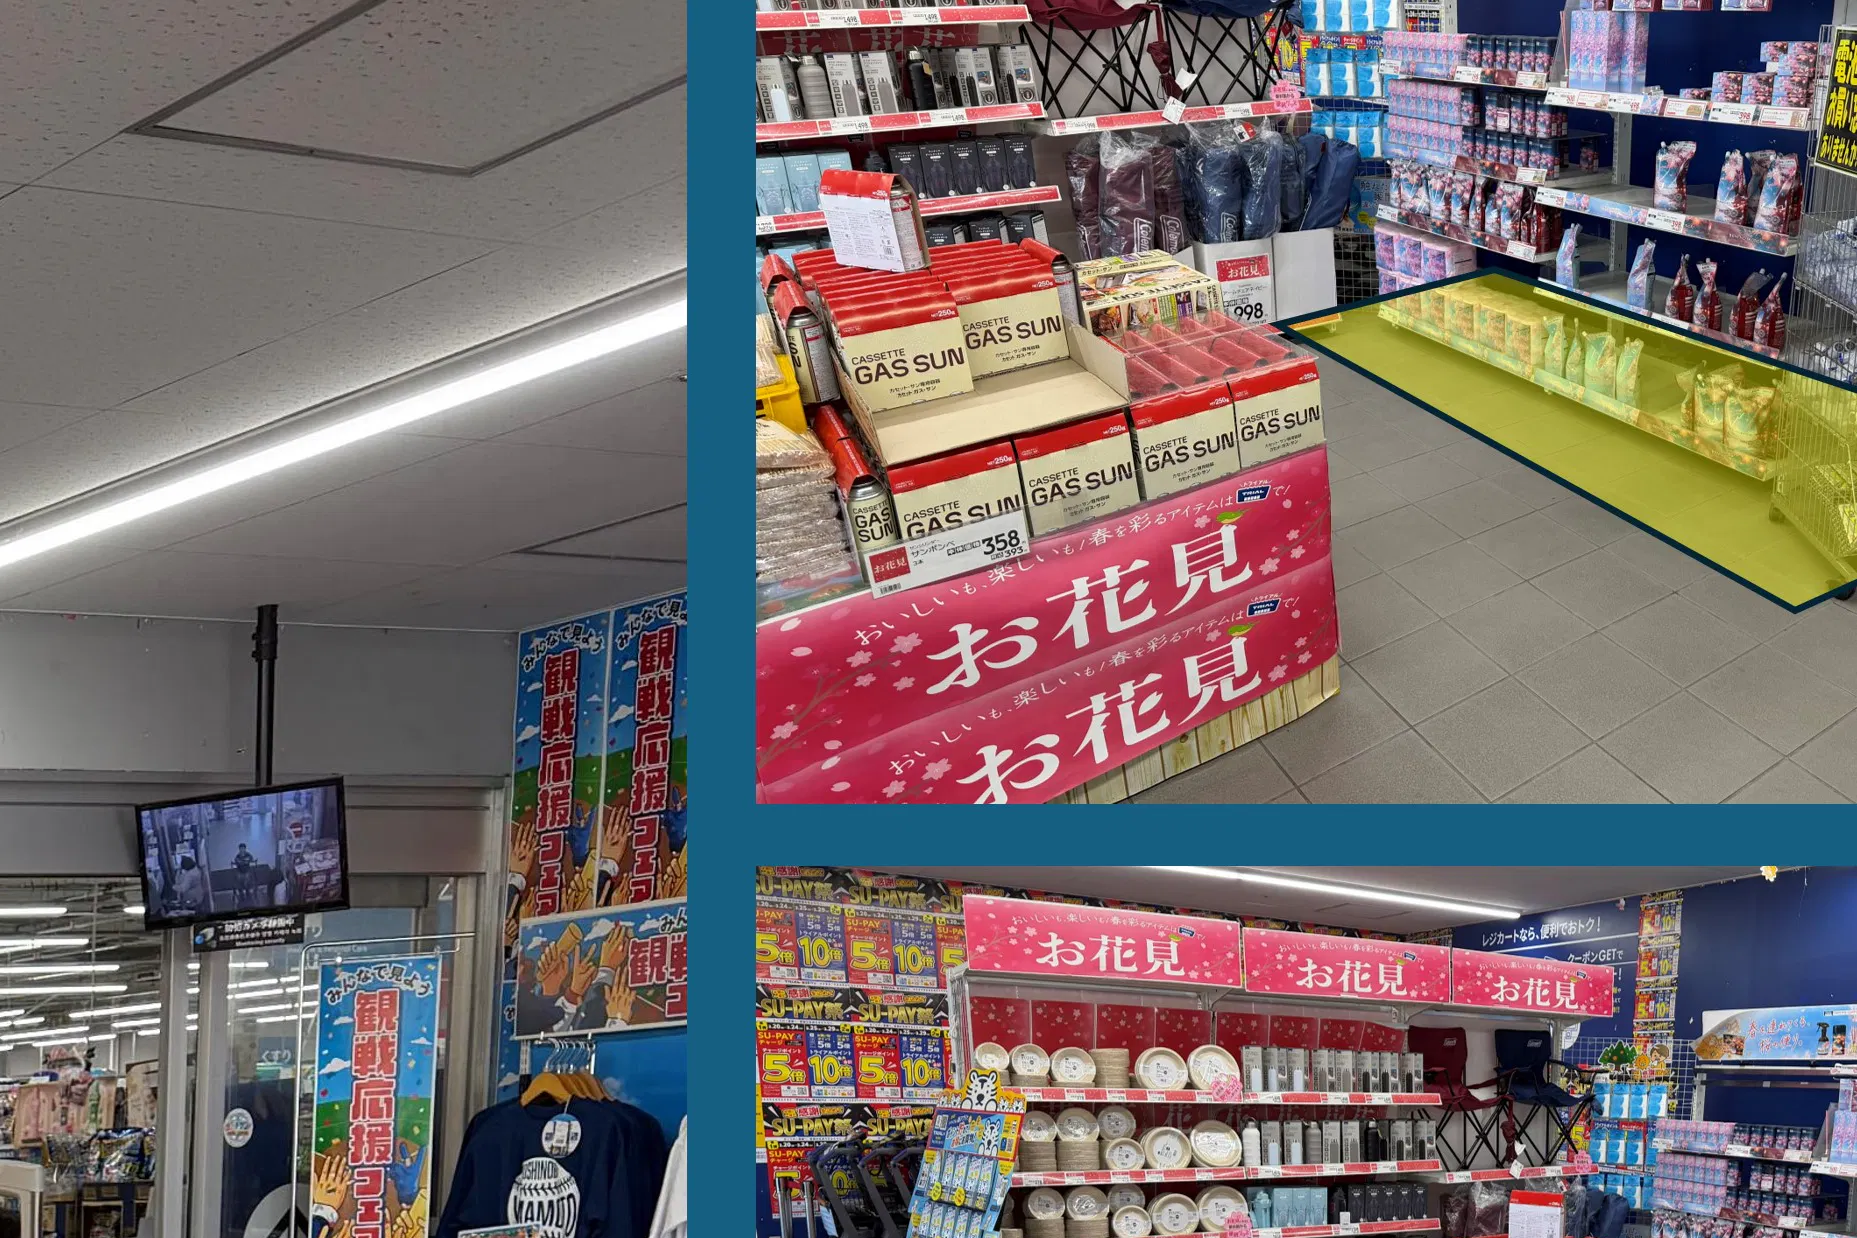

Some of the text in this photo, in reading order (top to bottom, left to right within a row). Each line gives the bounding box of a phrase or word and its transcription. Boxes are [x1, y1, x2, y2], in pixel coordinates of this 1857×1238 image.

[963, 316, 1010, 331] CASSETTE
[965, 315, 1061, 349] GAS SUN
[851, 348, 905, 365] CASSETTE
[855, 348, 965, 385] GAS SUN
[1240, 409, 1279, 426] CASSETTE
[1241, 405, 1320, 442] GAS SUN
[1144, 436, 1187, 454] CASSETTE
[1145, 431, 1234, 473] GAS SUN
[1029, 468, 1078, 488] CASSETTE
[1031, 461, 1133, 506] GAS SUN
[855, 507, 891, 529] GAS
[904, 501, 960, 522] CASSETTE
[858, 520, 894, 542] SUN
[981, 530, 1020, 555] 358
[874, 558, 908, 574] お花見
[1004, 546, 1024, 559] 393
[926, 524, 1253, 695] お花見
[1482, 917, 1601, 947] レジカートなら、便利でおトク!
[851, 940, 891, 971] 5倍
[895, 945, 935, 974] 10倍
[1036, 930, 1185, 977] お花見
[326, 964, 432, 1005] みんなで見よう
[1297, 956, 1408, 997] お花見
[1492, 975, 1579, 1010] お花見
[761, 998, 844, 1020] SU-PAY祭
[859, 1003, 934, 1024] SU-PAY祭
[757, 1032, 794, 1040] SU-PAY
[763, 1054, 806, 1083] 5倍
[808, 1055, 853, 1084] 10倍
[859, 1056, 898, 1085] 5倍
[902, 1057, 941, 1086] 10倍
